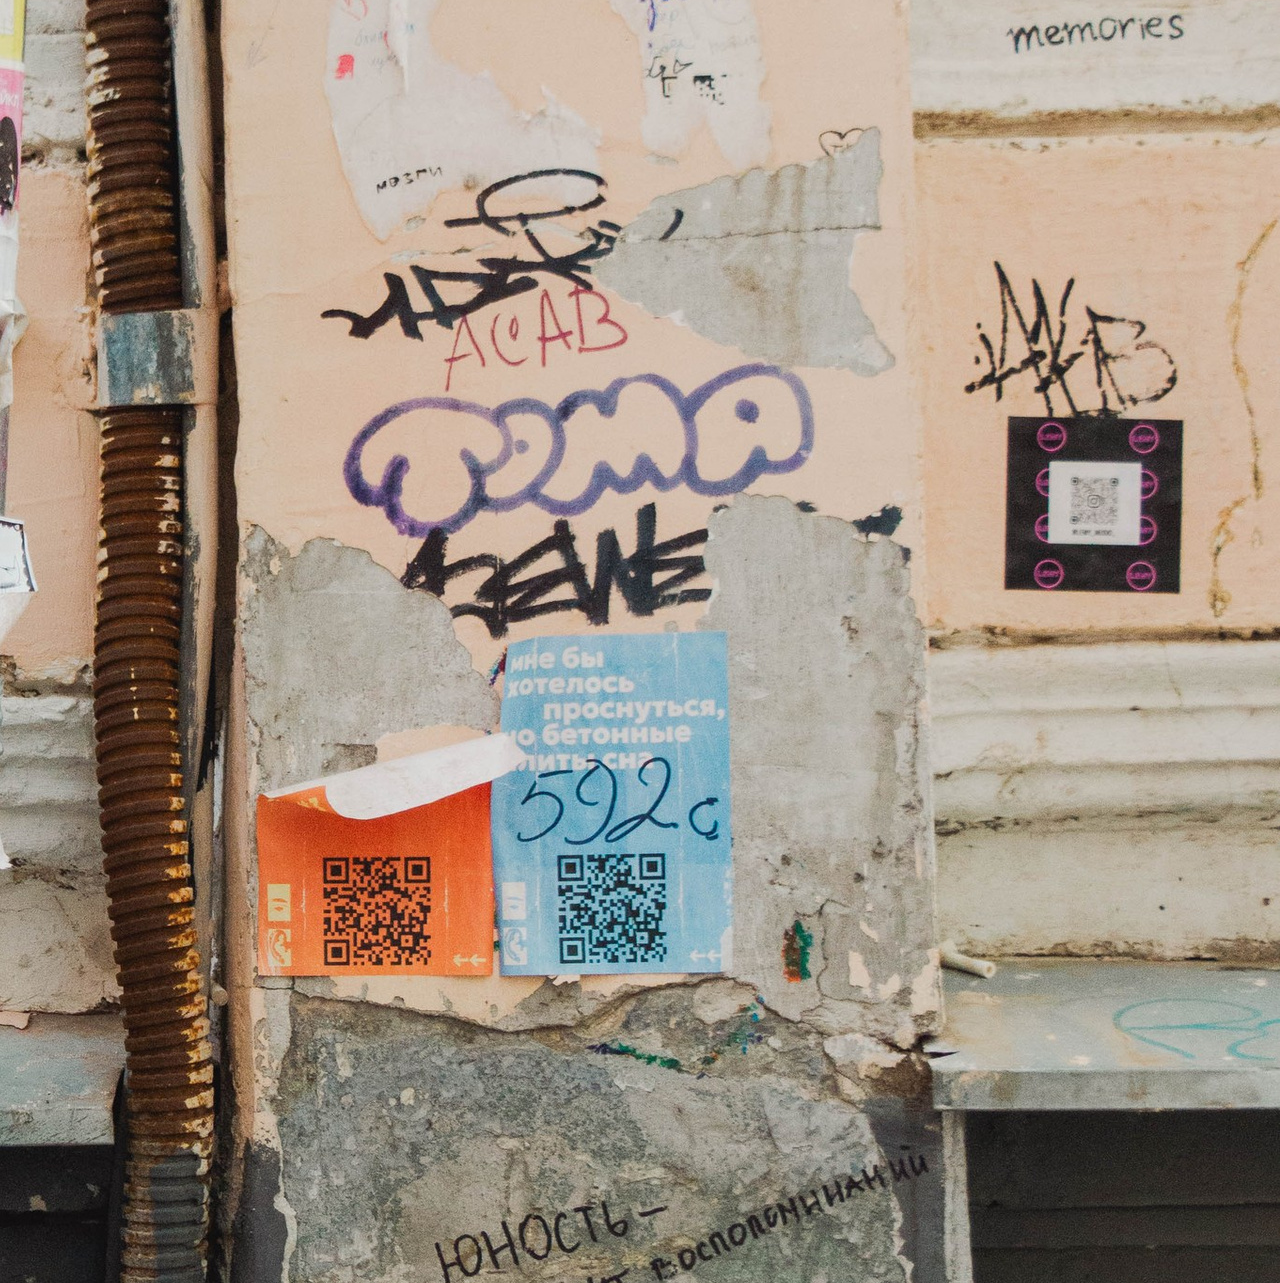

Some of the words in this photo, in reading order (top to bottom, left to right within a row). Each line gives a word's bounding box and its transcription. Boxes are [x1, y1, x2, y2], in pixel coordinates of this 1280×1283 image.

[1007, 13, 1185, 56] memories
[510, 651, 556, 673] мне
[562, 646, 604, 669] бы
[507, 675, 635, 698] хотелось
[543, 699, 726, 725] проснуться,
[542, 723, 692, 746] бетонные
[517, 751, 602, 772] литы
